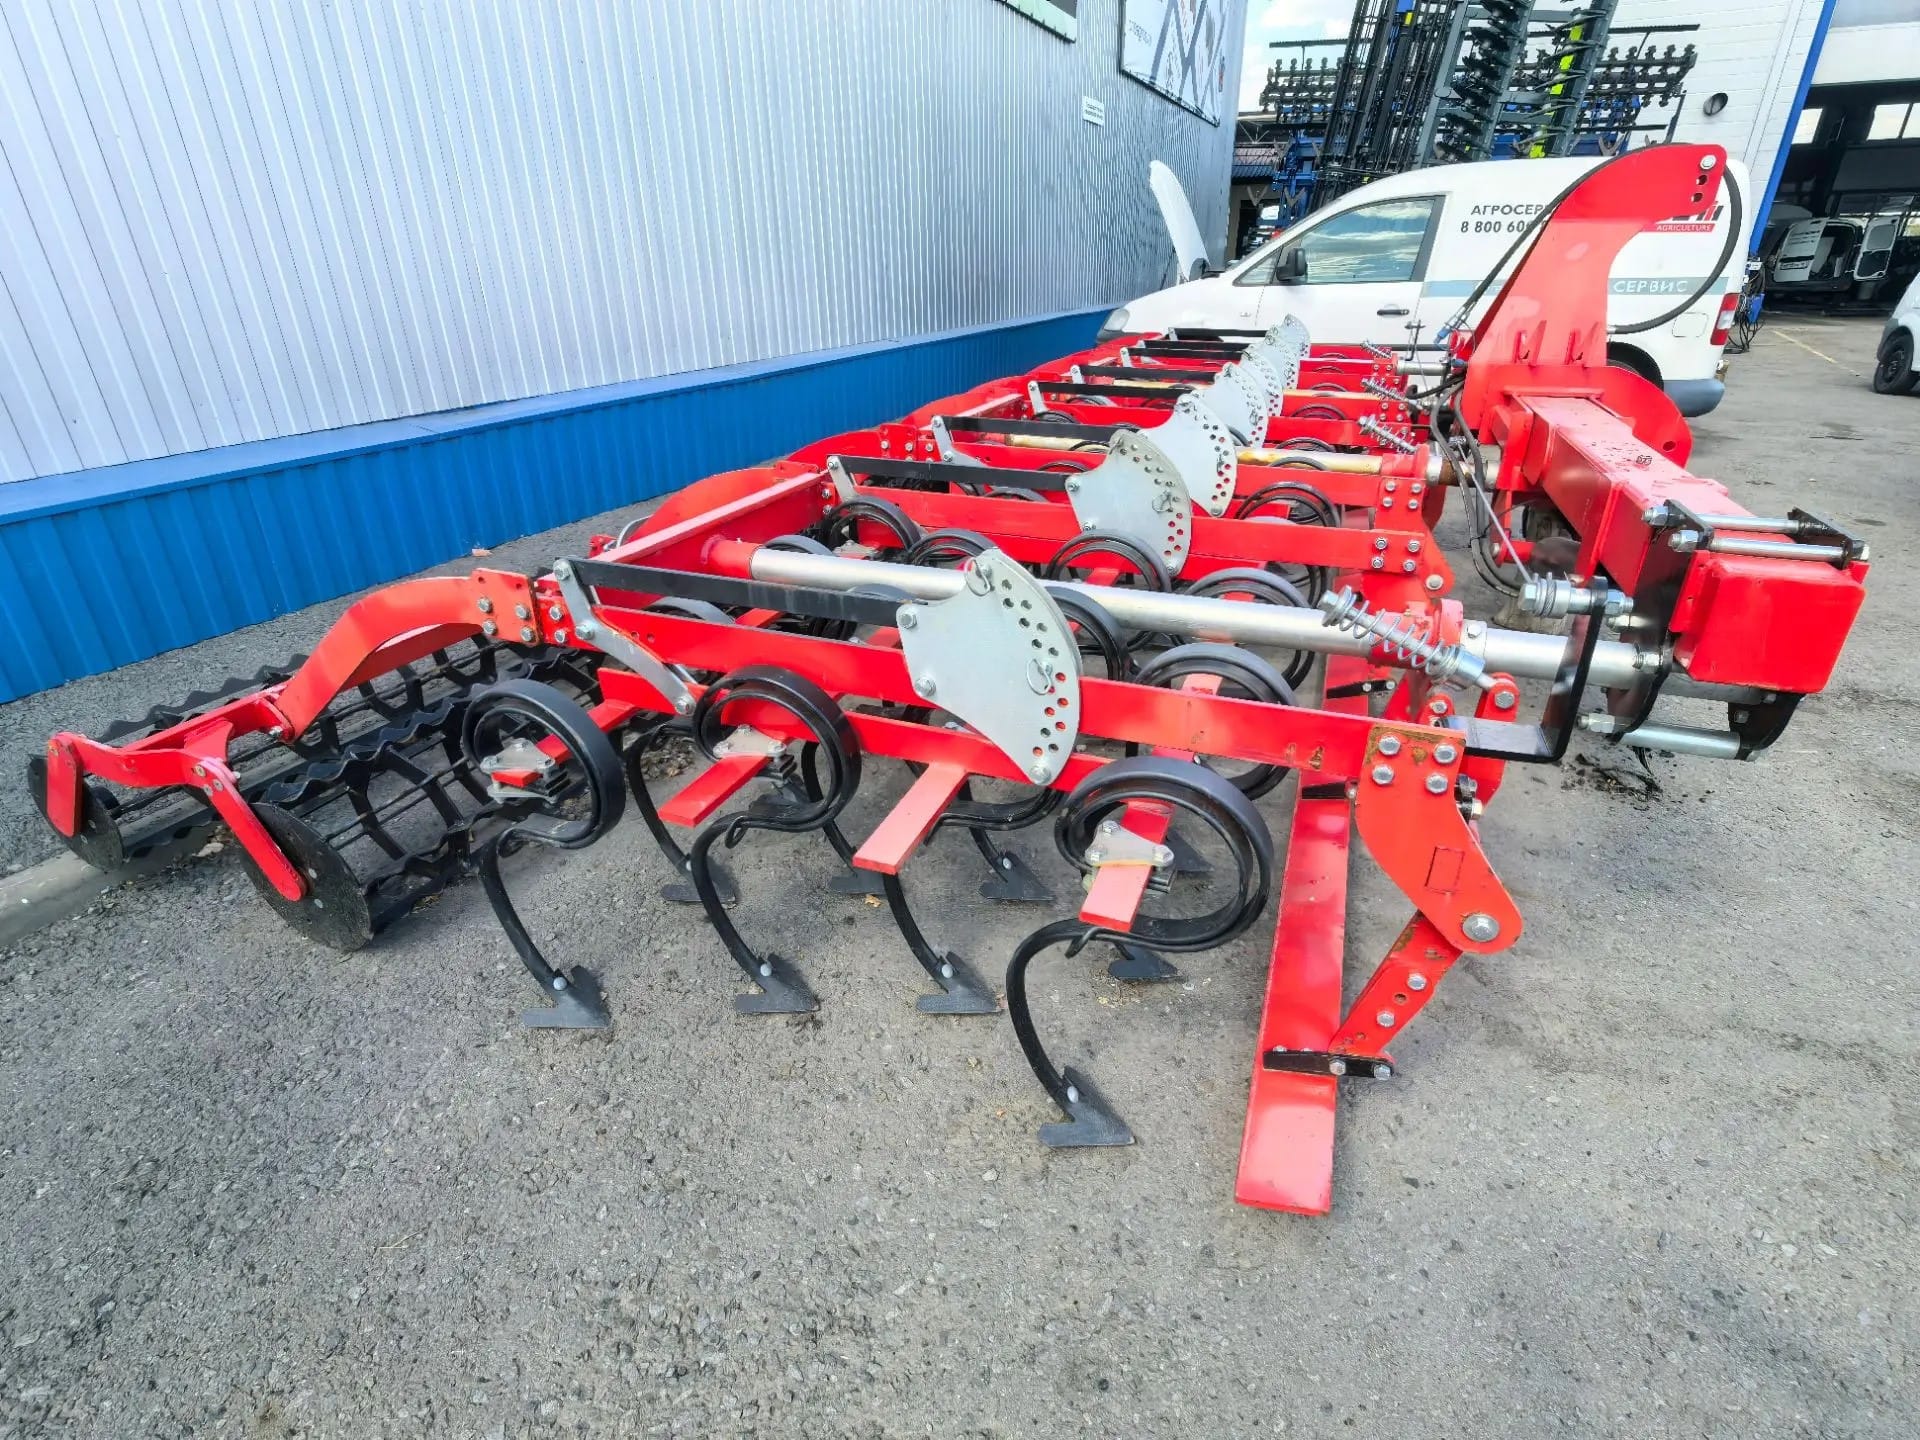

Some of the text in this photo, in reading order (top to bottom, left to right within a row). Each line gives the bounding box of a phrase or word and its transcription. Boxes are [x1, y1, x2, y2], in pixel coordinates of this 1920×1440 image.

[1470, 204, 1547, 216] АГРОСЕР
[1460, 221, 1469, 233] 8
[1474, 221, 1502, 233] 800
[1507, 220, 1531, 233] 60
[1656, 224, 1712, 232] AGRICULTURE
[1613, 280, 1689, 293] СЕРВИС
